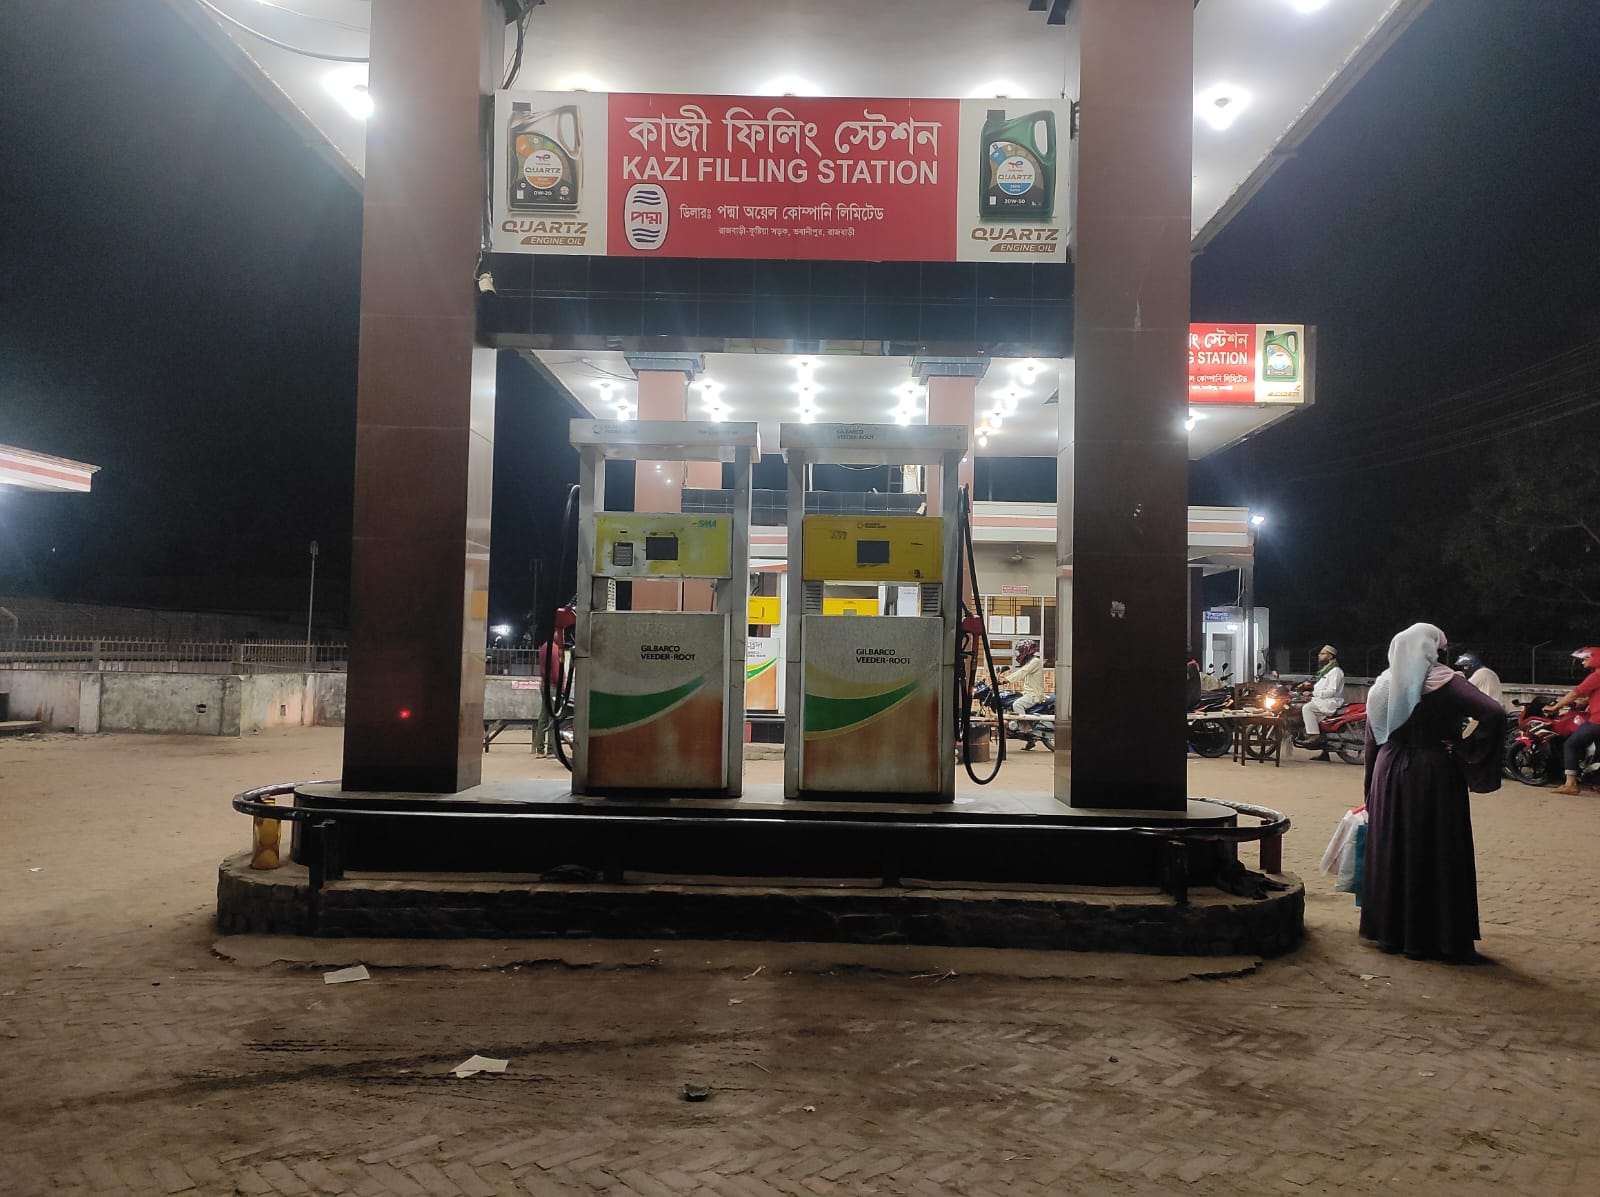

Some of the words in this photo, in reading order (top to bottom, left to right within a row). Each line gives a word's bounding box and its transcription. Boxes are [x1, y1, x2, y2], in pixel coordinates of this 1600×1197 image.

[624, 104, 712, 153] কাজী
[721, 107, 822, 157] ফিলিং
[834, 108, 942, 156] স্টেশন
[623, 156, 689, 181] KAZI
[698, 158, 808, 183] FILLING
[817, 160, 938, 185] STATION
[630, 210, 663, 226] পদ্মা
[717, 204, 739, 221] পদ্মা
[743, 205, 778, 221] অয়েল
[782, 202, 832, 222] কোম্পানি
[836, 202, 885, 222] লিমিটেড
[501, 220, 589, 235] QUARTZ
[971, 227, 1060, 242] QUARTZ
[530, 236, 565, 246] ENGINE
[567, 237, 583, 246] OIL
[1000, 243, 1036, 253] ENGINE
[1038, 243, 1054, 253] OIL
[1204, 328, 1249, 350] স্টেশন
[1197, 351, 1248, 365] STATION
[640, 644, 680, 652] GILBARCO
